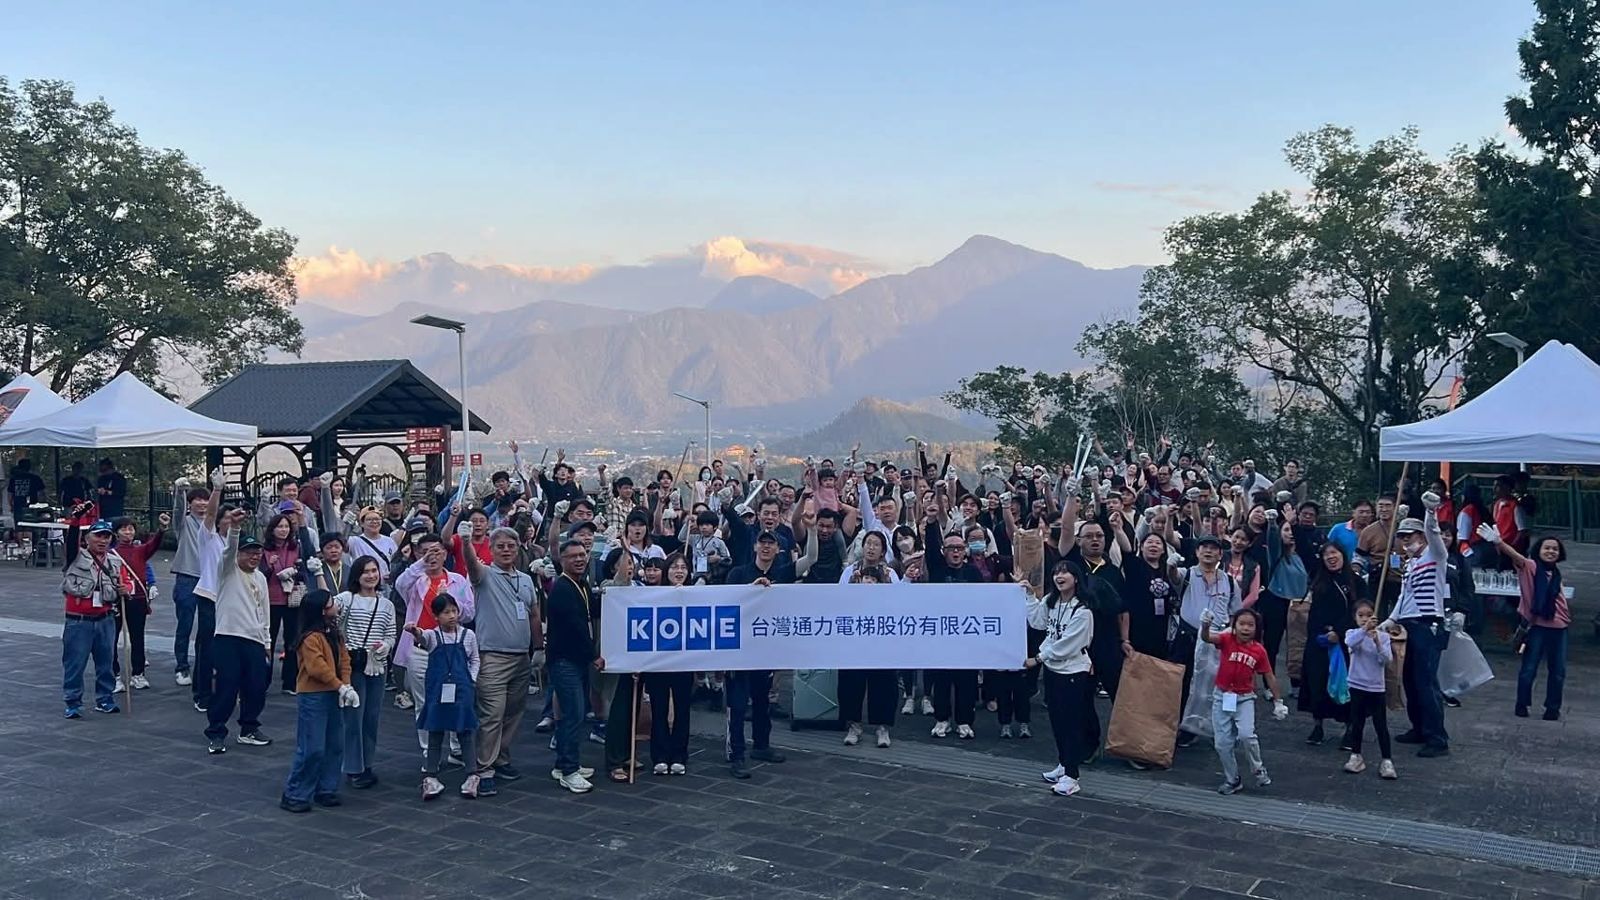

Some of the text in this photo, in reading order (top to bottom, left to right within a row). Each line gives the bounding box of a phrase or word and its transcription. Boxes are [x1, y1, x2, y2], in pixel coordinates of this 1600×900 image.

[631, 617, 736, 640] KONE
[751, 615, 1002, 638] 台灣通力電梯股份有限公司
